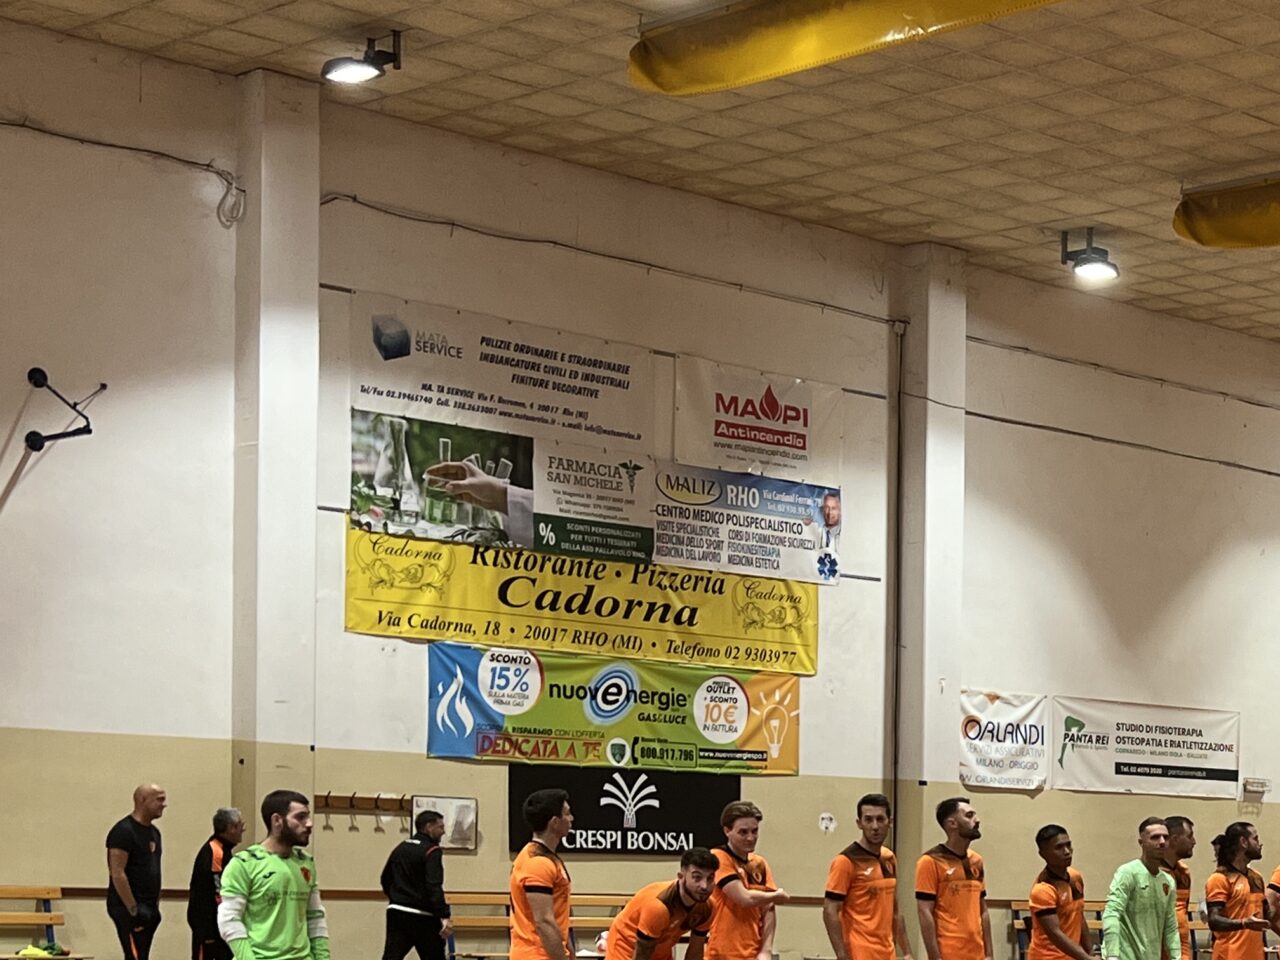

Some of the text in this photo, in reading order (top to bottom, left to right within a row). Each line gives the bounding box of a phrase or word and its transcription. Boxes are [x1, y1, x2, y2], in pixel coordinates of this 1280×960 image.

[415, 341, 463, 359] SERVICE
[480, 336, 631, 375] PULIZIE ORDINARIE E STRAORDINARIE
[479, 352, 630, 390] IMBIANCATURE CIVILI ED INDUSTRIALI
[446, 387, 475, 399] SERVICE
[511, 374, 600, 399] FINITURE DECORATIVE
[716, 423, 804, 447] Antincendio
[547, 456, 622, 479] FARMACIA
[546, 471, 623, 491] SAN MICHELE
[665, 474, 717, 497] MALIZ
[726, 484, 760, 508] RHO
[656, 504, 803, 535] CENTRO MEDICO POLISPECIALISTICO
[656, 520, 720, 538] VISITE SPECIALISTICHE
[539, 522, 556, 546] %
[656, 532, 724, 551] MEDICINA DELLO SPORT
[751, 532, 787, 547] FORMAZIONE
[369, 533, 444, 561] Cadorna
[656, 544, 721, 563] MEDICINA DEL LAVORO
[469, 544, 726, 595] Ristorante Pizzeria
[727, 554, 780, 570] MEDICINA ESTETICA
[497, 575, 700, 628] Cadorna
[743, 579, 802, 605] Cadorna
[377, 609, 798, 665] Via Cadorna, 18 20017 RHO (MI) Telefono 02 9303977
[489, 653, 531, 665] SCONTO
[489, 667, 530, 692] 15%
[706, 685, 736, 694] OUTLET
[709, 696, 738, 704] SCONTO
[704, 703, 738, 724] 10€
[710, 724, 738, 733] FATTURA
[964, 719, 1044, 746] ORLANDI
[1064, 733, 1109, 745] PANTA REI
[1115, 722, 1203, 737] STUDIO DI FISIOTERAPIA
[479, 735, 560, 758] DEDICATA
[564, 742, 576, 758] A
[1115, 736, 1163, 748] OSTEOPATIA
[1164, 739, 1169, 748] E
[1170, 739, 1234, 753] RIATLETIZZAZIONE
[976, 759, 1004, 768] MILANO
[561, 829, 694, 850] CRESPI BONSAI
